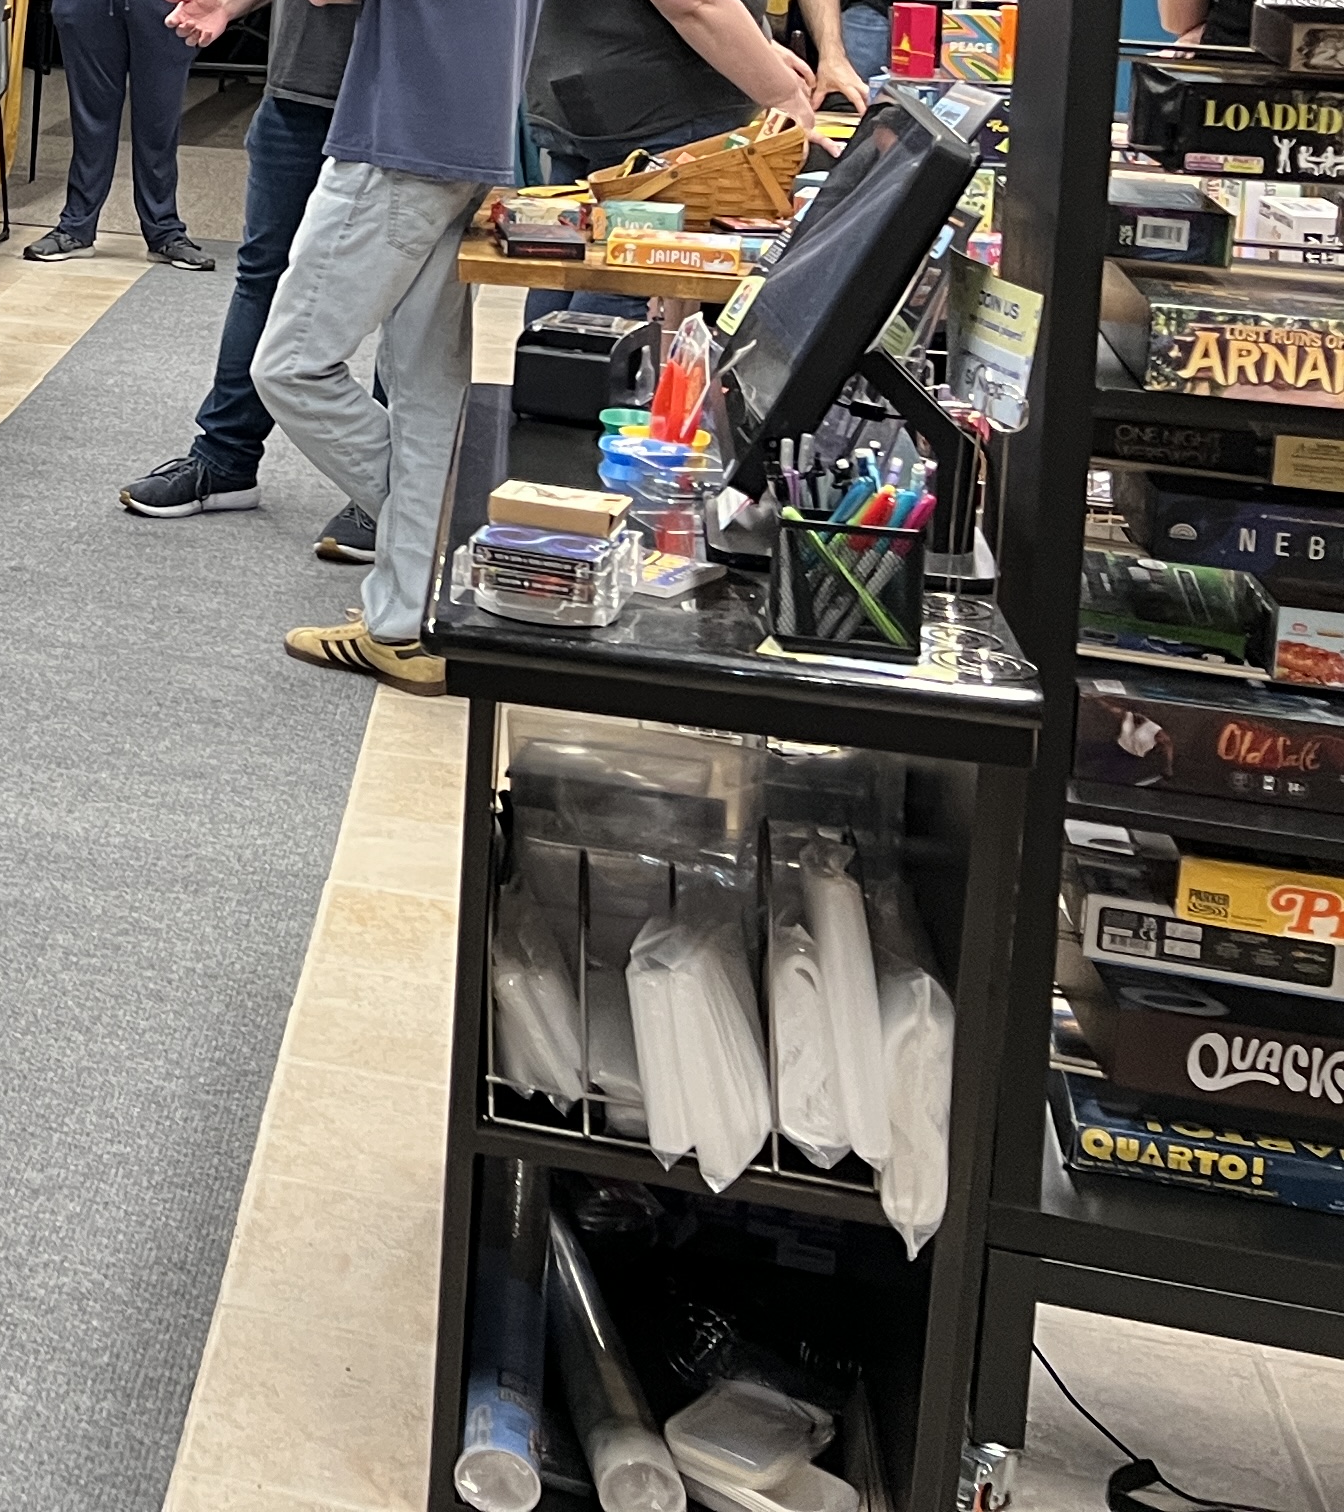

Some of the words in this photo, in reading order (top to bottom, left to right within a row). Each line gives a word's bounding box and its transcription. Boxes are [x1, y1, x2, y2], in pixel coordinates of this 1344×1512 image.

[949, 41, 994, 54] PEACE
[1203, 99, 1344, 135] LOADED
[646, 248, 701, 268] JAIPUR
[1003, 300, 1021, 320] US
[1225, 326, 1267, 344] LOST
[1269, 330, 1322, 348] RUINS
[1239, 528, 1344, 560] NEB
[1187, 1032, 1344, 1105] QUACK
[1081, 1128, 1265, 1186] QUARTO!
